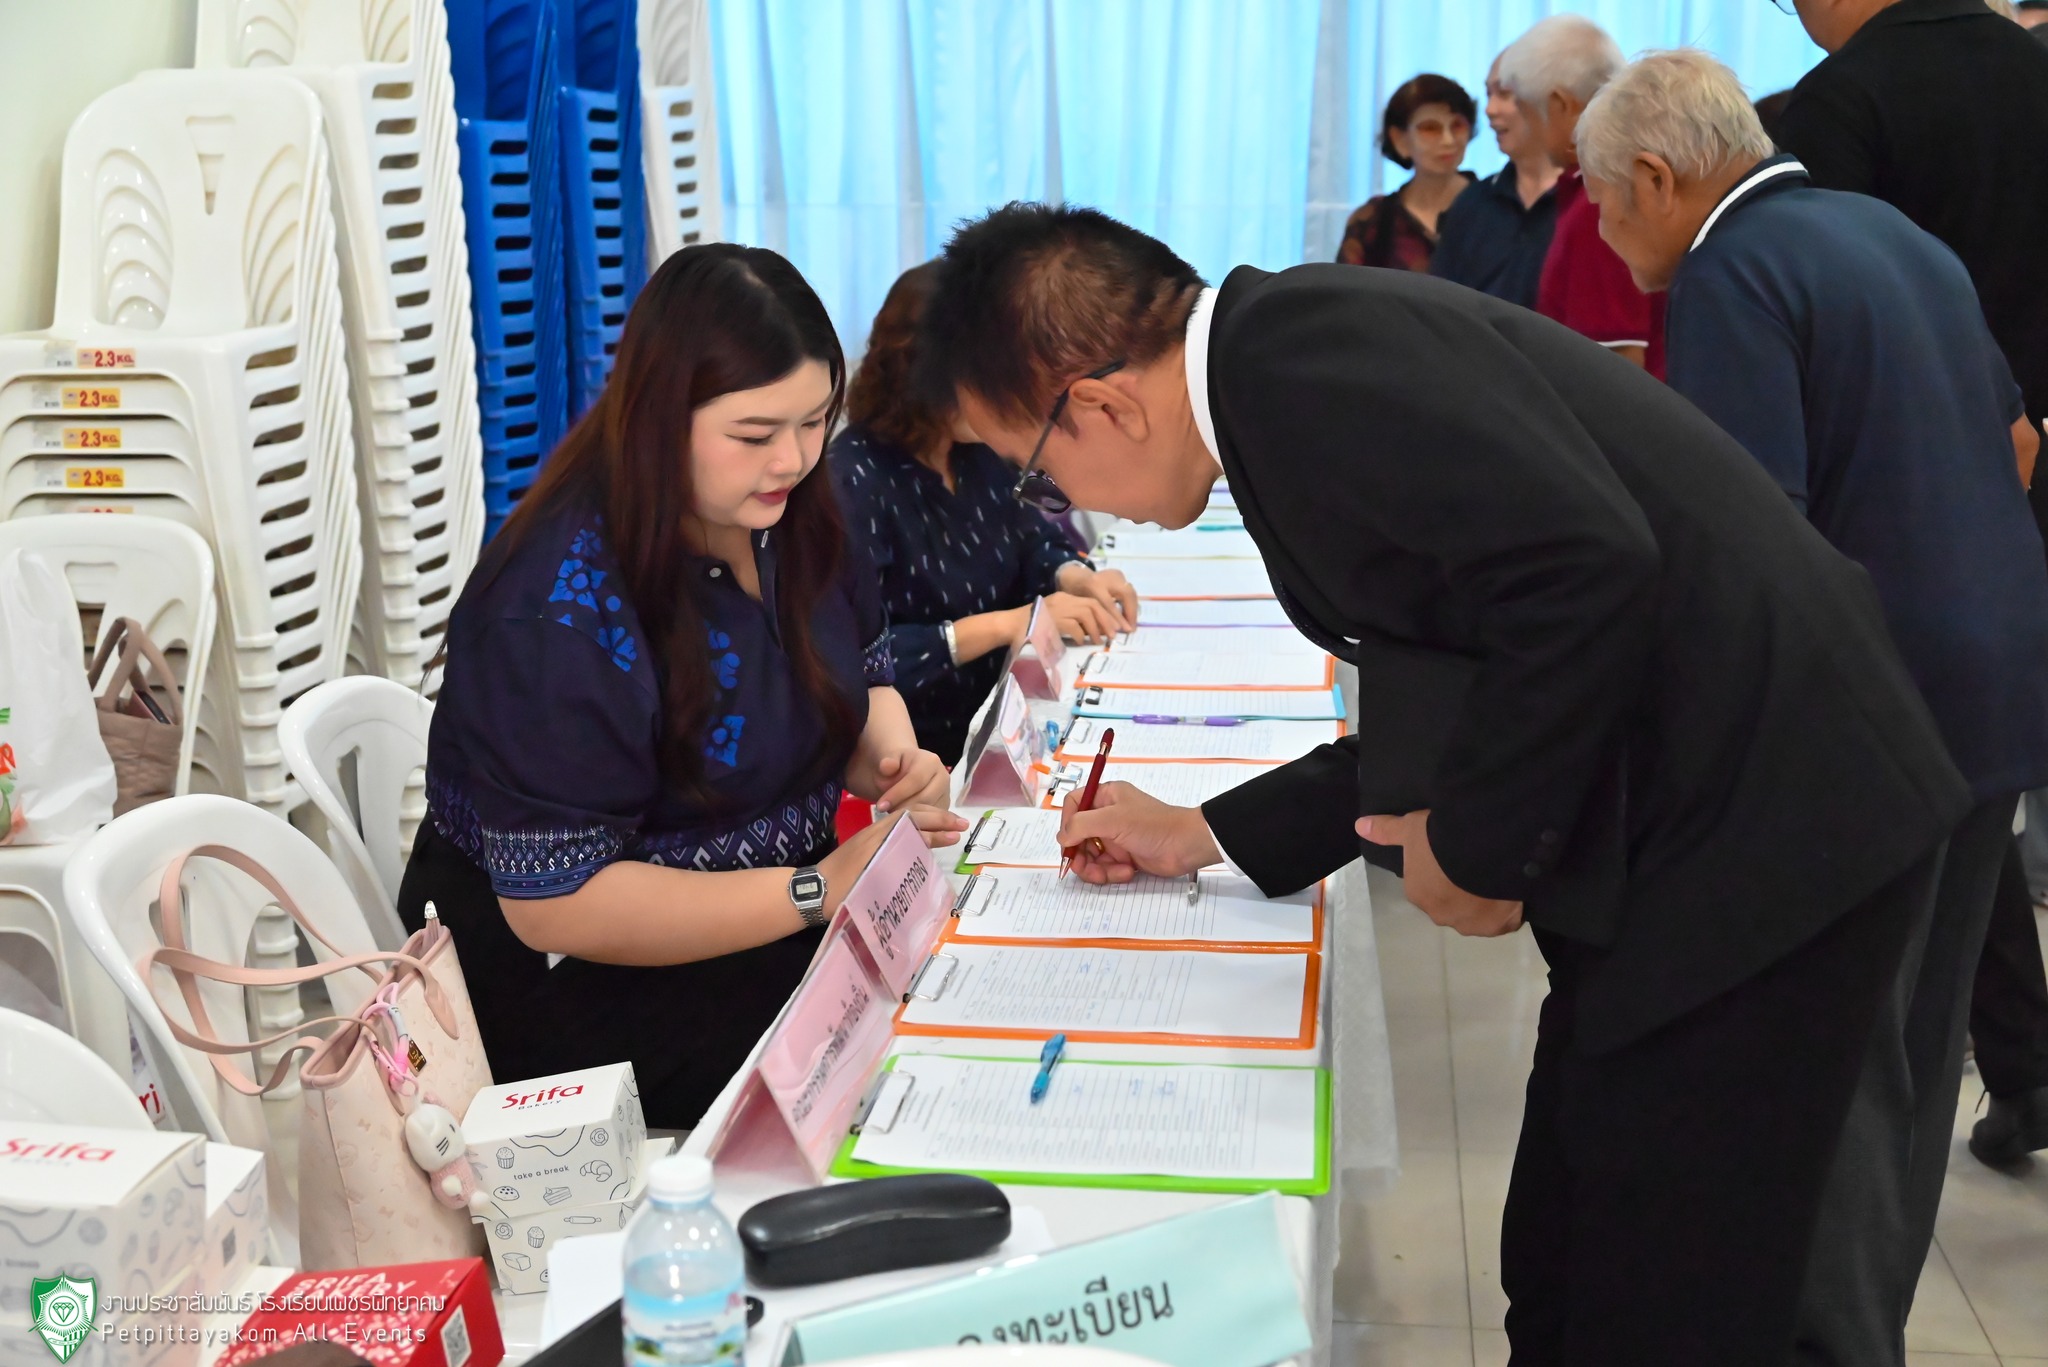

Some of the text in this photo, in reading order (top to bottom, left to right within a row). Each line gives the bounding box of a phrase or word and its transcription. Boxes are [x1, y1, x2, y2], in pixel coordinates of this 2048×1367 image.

[94, 350, 115, 367] 2.3
[79, 390, 100, 407] 2.3
[80, 430, 101, 447] 2.3
[83, 470, 104, 486] 2.3
[868, 856, 928, 960] ผู้อำนวยการกอง
[501, 1085, 584, 1109] Srifa
[0, 1138, 115, 1161] Srifa
[514, 1172, 533, 1180] take
[544, 1165, 570, 1175] break
